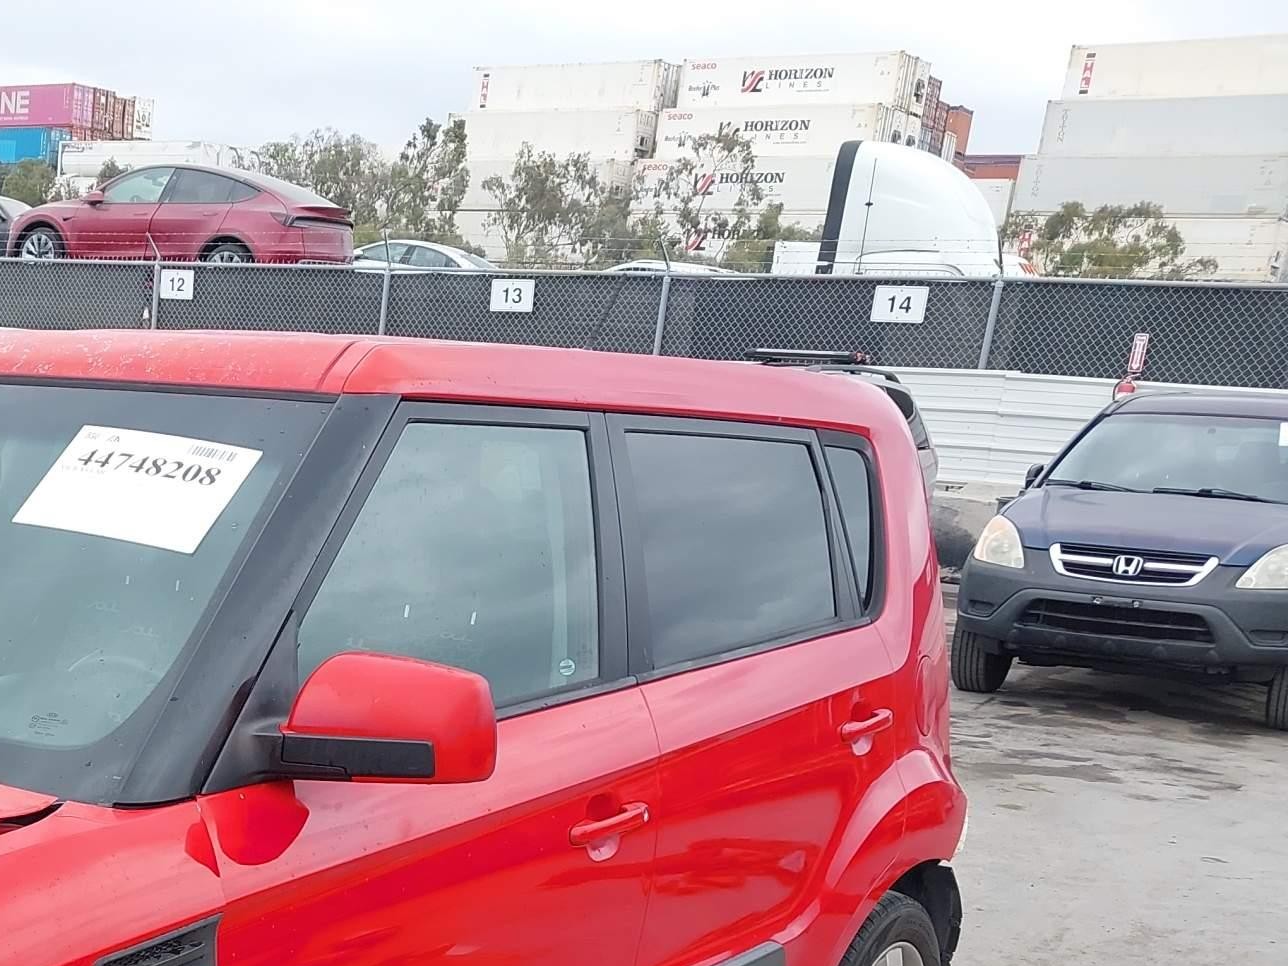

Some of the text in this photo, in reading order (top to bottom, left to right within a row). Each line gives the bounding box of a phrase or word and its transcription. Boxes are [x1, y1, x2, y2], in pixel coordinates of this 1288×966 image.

[691, 62, 717, 71] seaco
[768, 67, 834, 81] HORIZON
[765, 81, 822, 89] LINES
[743, 119, 811, 132] HORIZON
[169, 277, 185, 292] 12
[502, 287, 522, 304] 13
[887, 295, 912, 314] 14
[77, 447, 222, 487] 44748208
